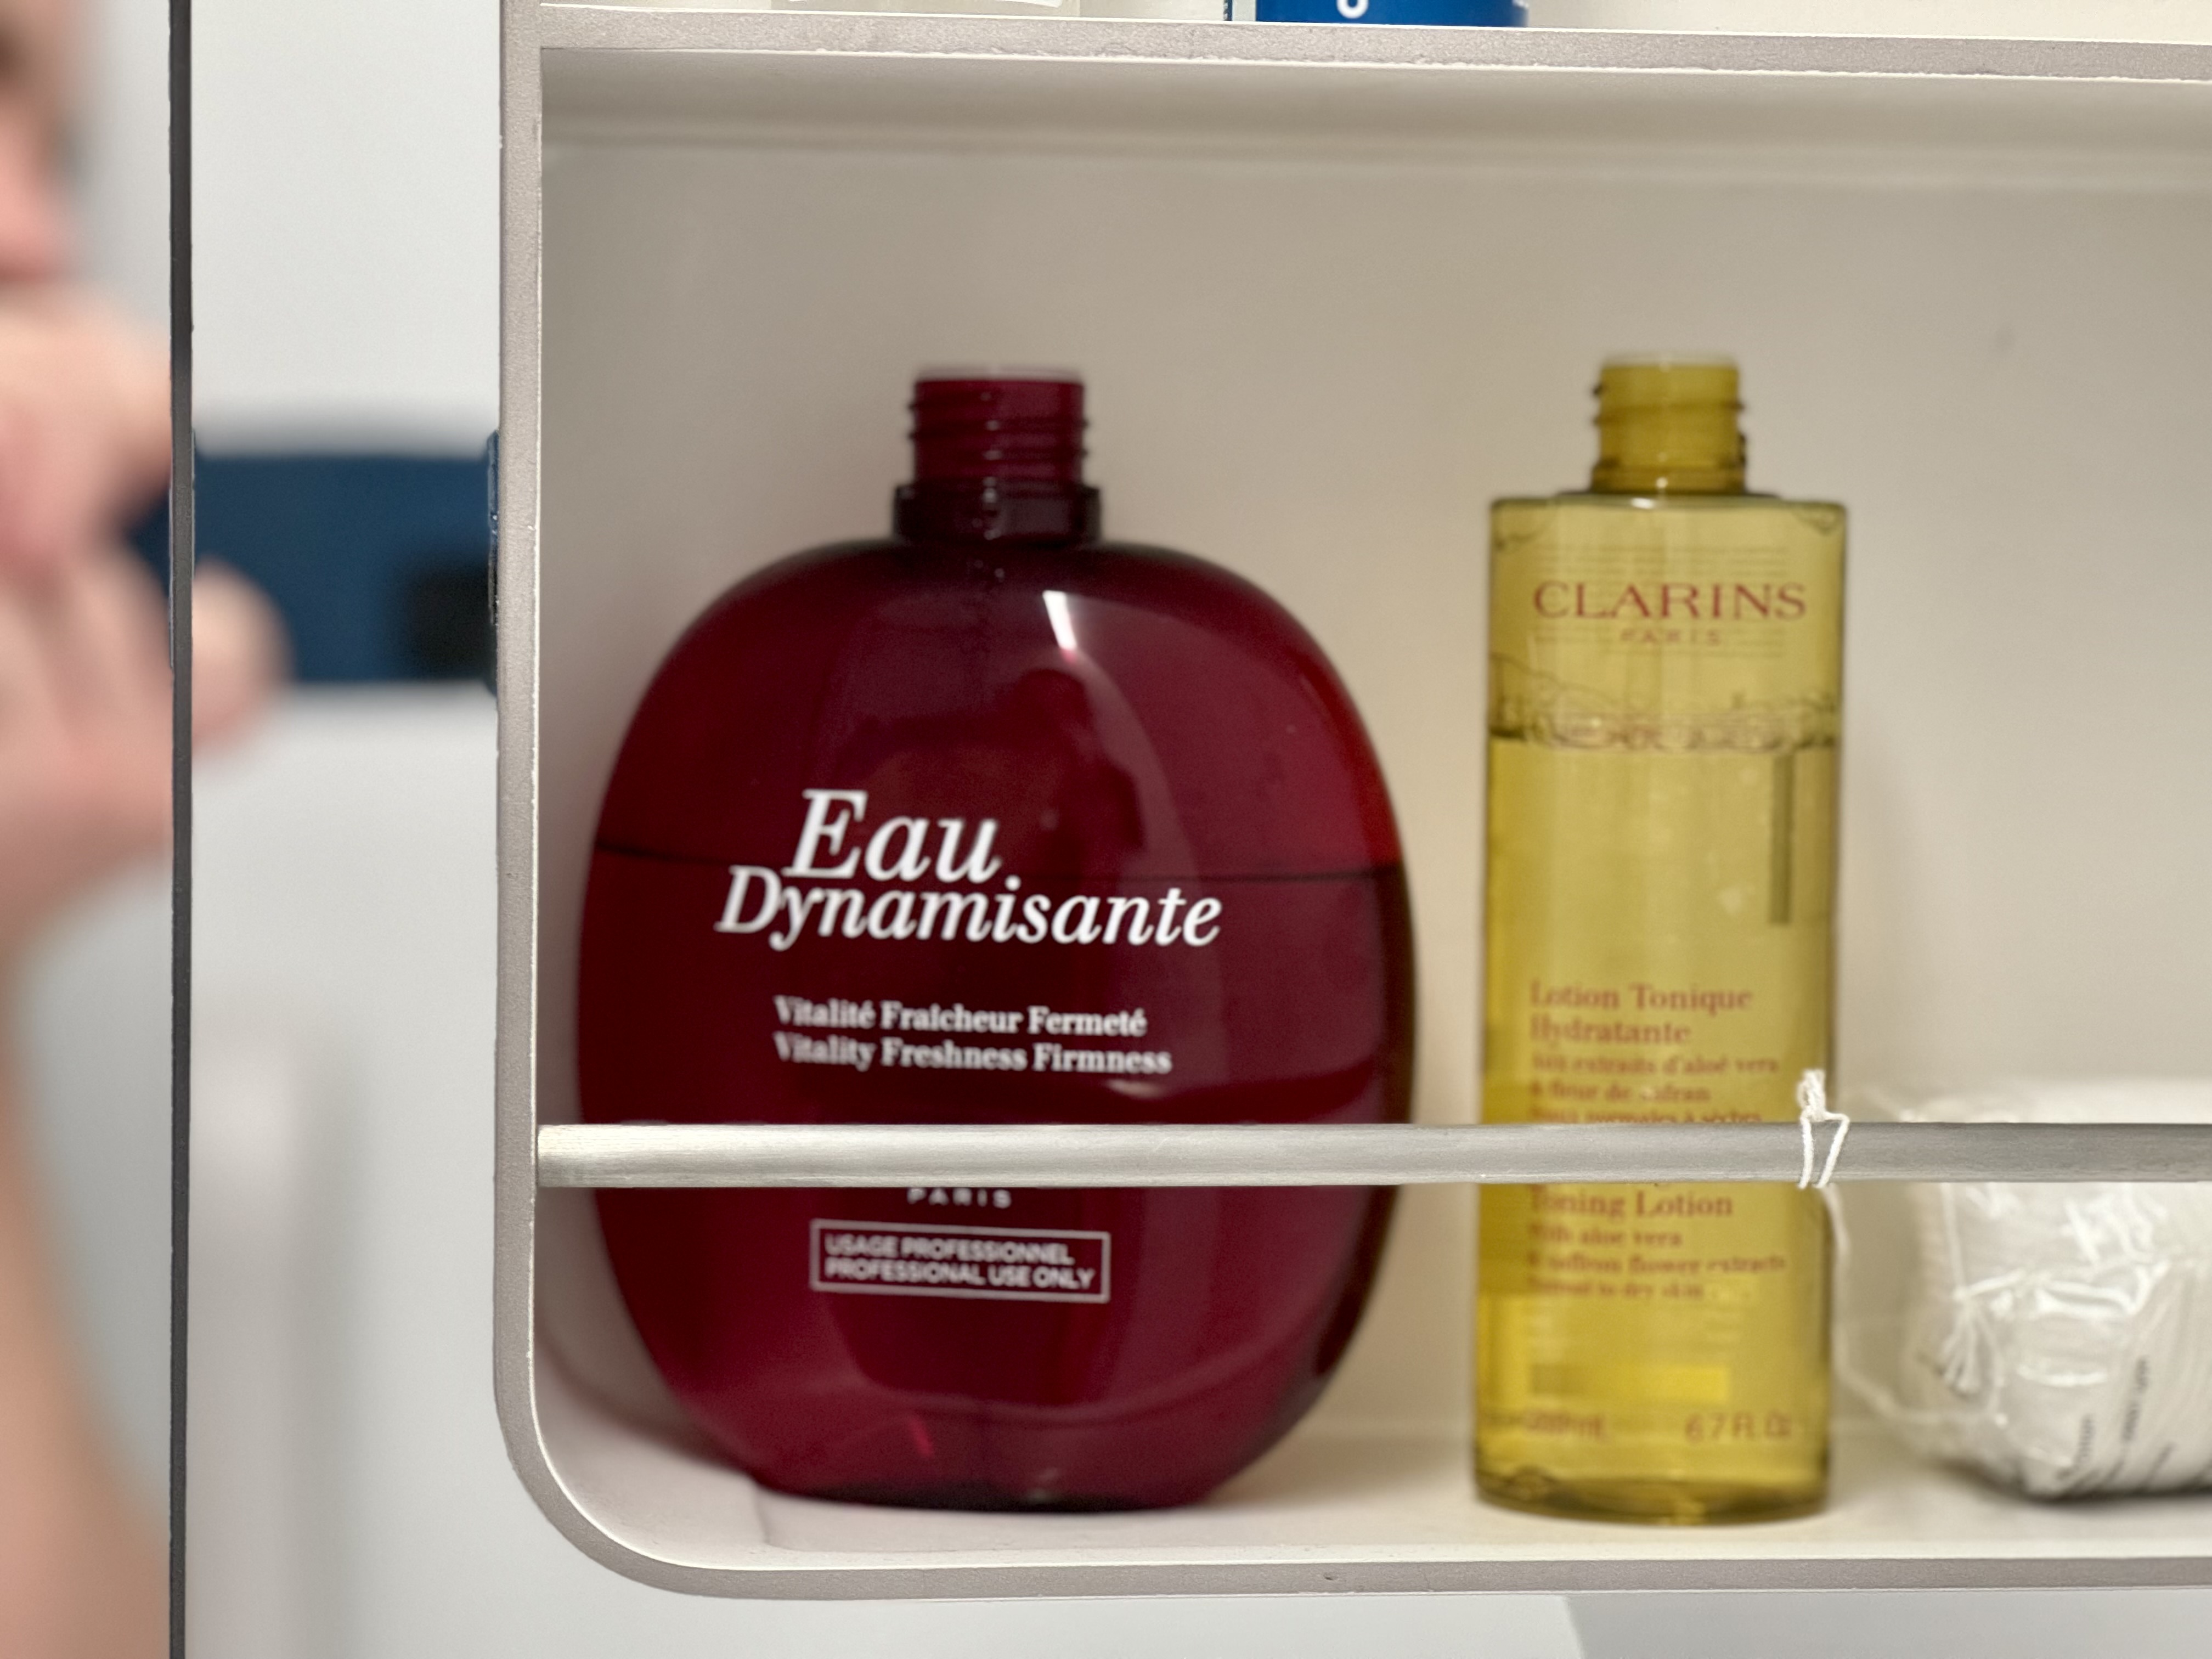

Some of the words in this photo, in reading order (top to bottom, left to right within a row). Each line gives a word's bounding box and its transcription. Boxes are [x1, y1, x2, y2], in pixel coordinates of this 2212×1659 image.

[1533, 580, 1807, 621] CLARINS
[782, 788, 1002, 883] Eau
[714, 865, 1222, 951] Dynamisante
[774, 995, 876, 1029] Vitalité
[1028, 1005, 1147, 1037] Fermeté
[1530, 978, 1620, 1010] Lotion
[1629, 983, 1753, 1017] Tonique
[1530, 1012, 1691, 1047] Hydratante
[774, 1031, 876, 1072] Vitality
[880, 1037, 1027, 1070] Freshness
[1032, 1042, 1172, 1074] Firmness
[906, 1187, 1012, 1209] PARIS
[1636, 1191, 1734, 1216] Lotion
[825, 1234, 899, 1257] USAGE
[901, 1237, 1075, 1266] PROFESSIONNEL
[825, 1256, 986, 1286] PROFESSIONAL
[989, 1265, 1032, 1288] USE
[1032, 1266, 1096, 1289] ONLY
